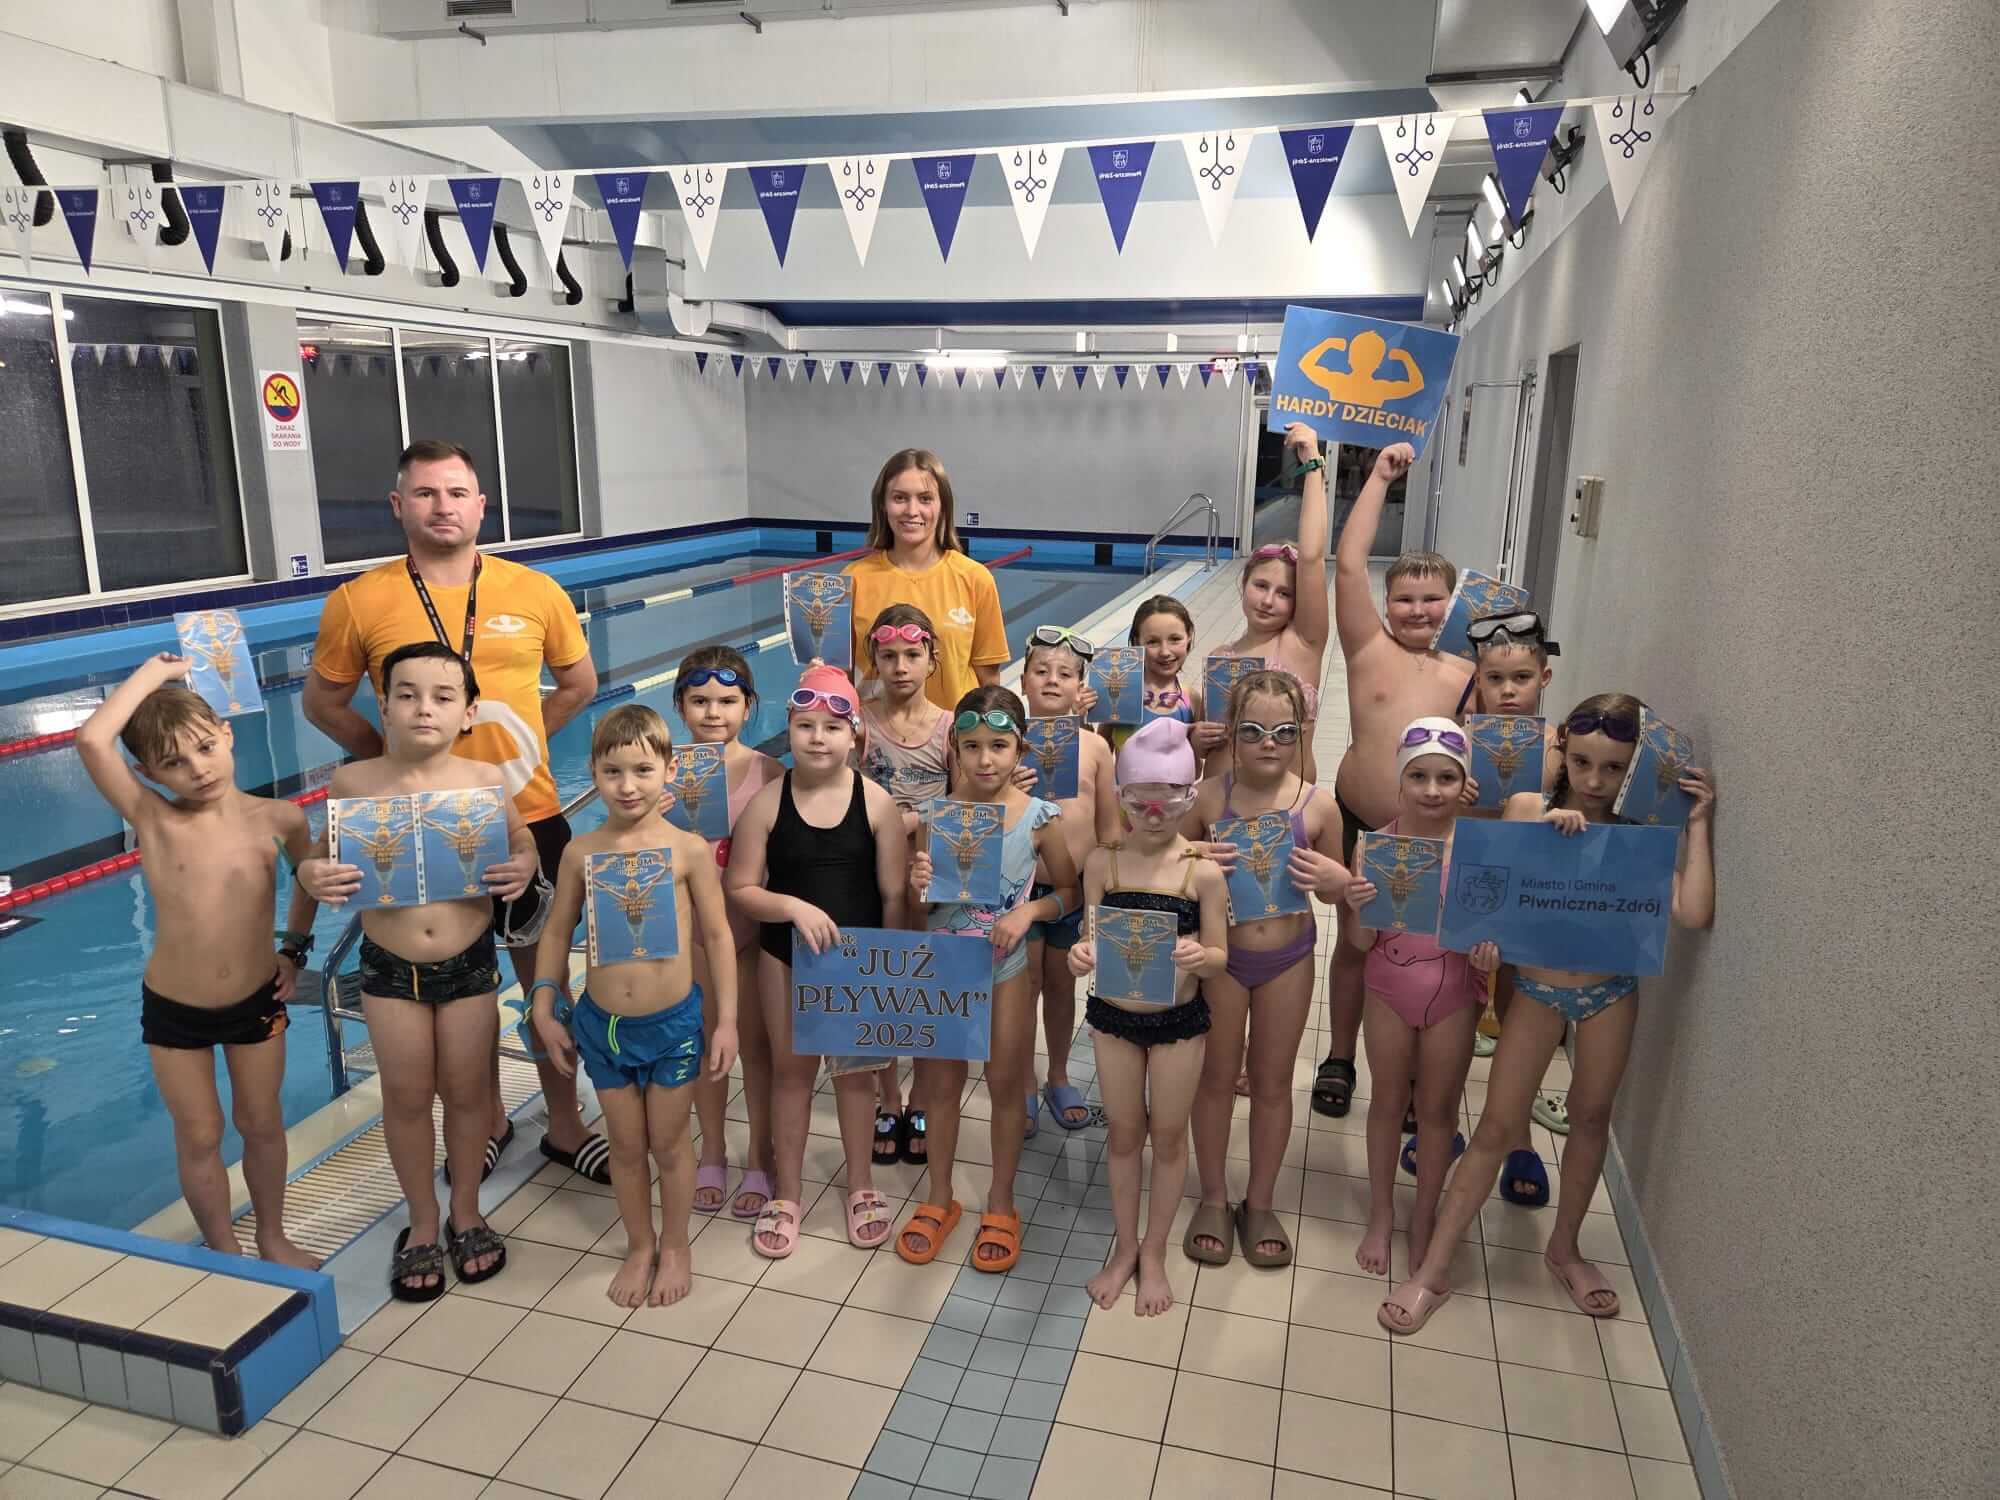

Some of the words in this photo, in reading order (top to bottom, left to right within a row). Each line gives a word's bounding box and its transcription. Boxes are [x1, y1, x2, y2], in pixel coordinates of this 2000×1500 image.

[1276, 394, 1339, 418] HARDY
[1341, 404, 1429, 437] DZIECIAK
[1520, 878, 1566, 891] Miasto
[1574, 879, 1617, 893] Gmina
[1519, 893, 1662, 918] Piwniczna-Zdrój
[855, 1022, 936, 1049] 2025
